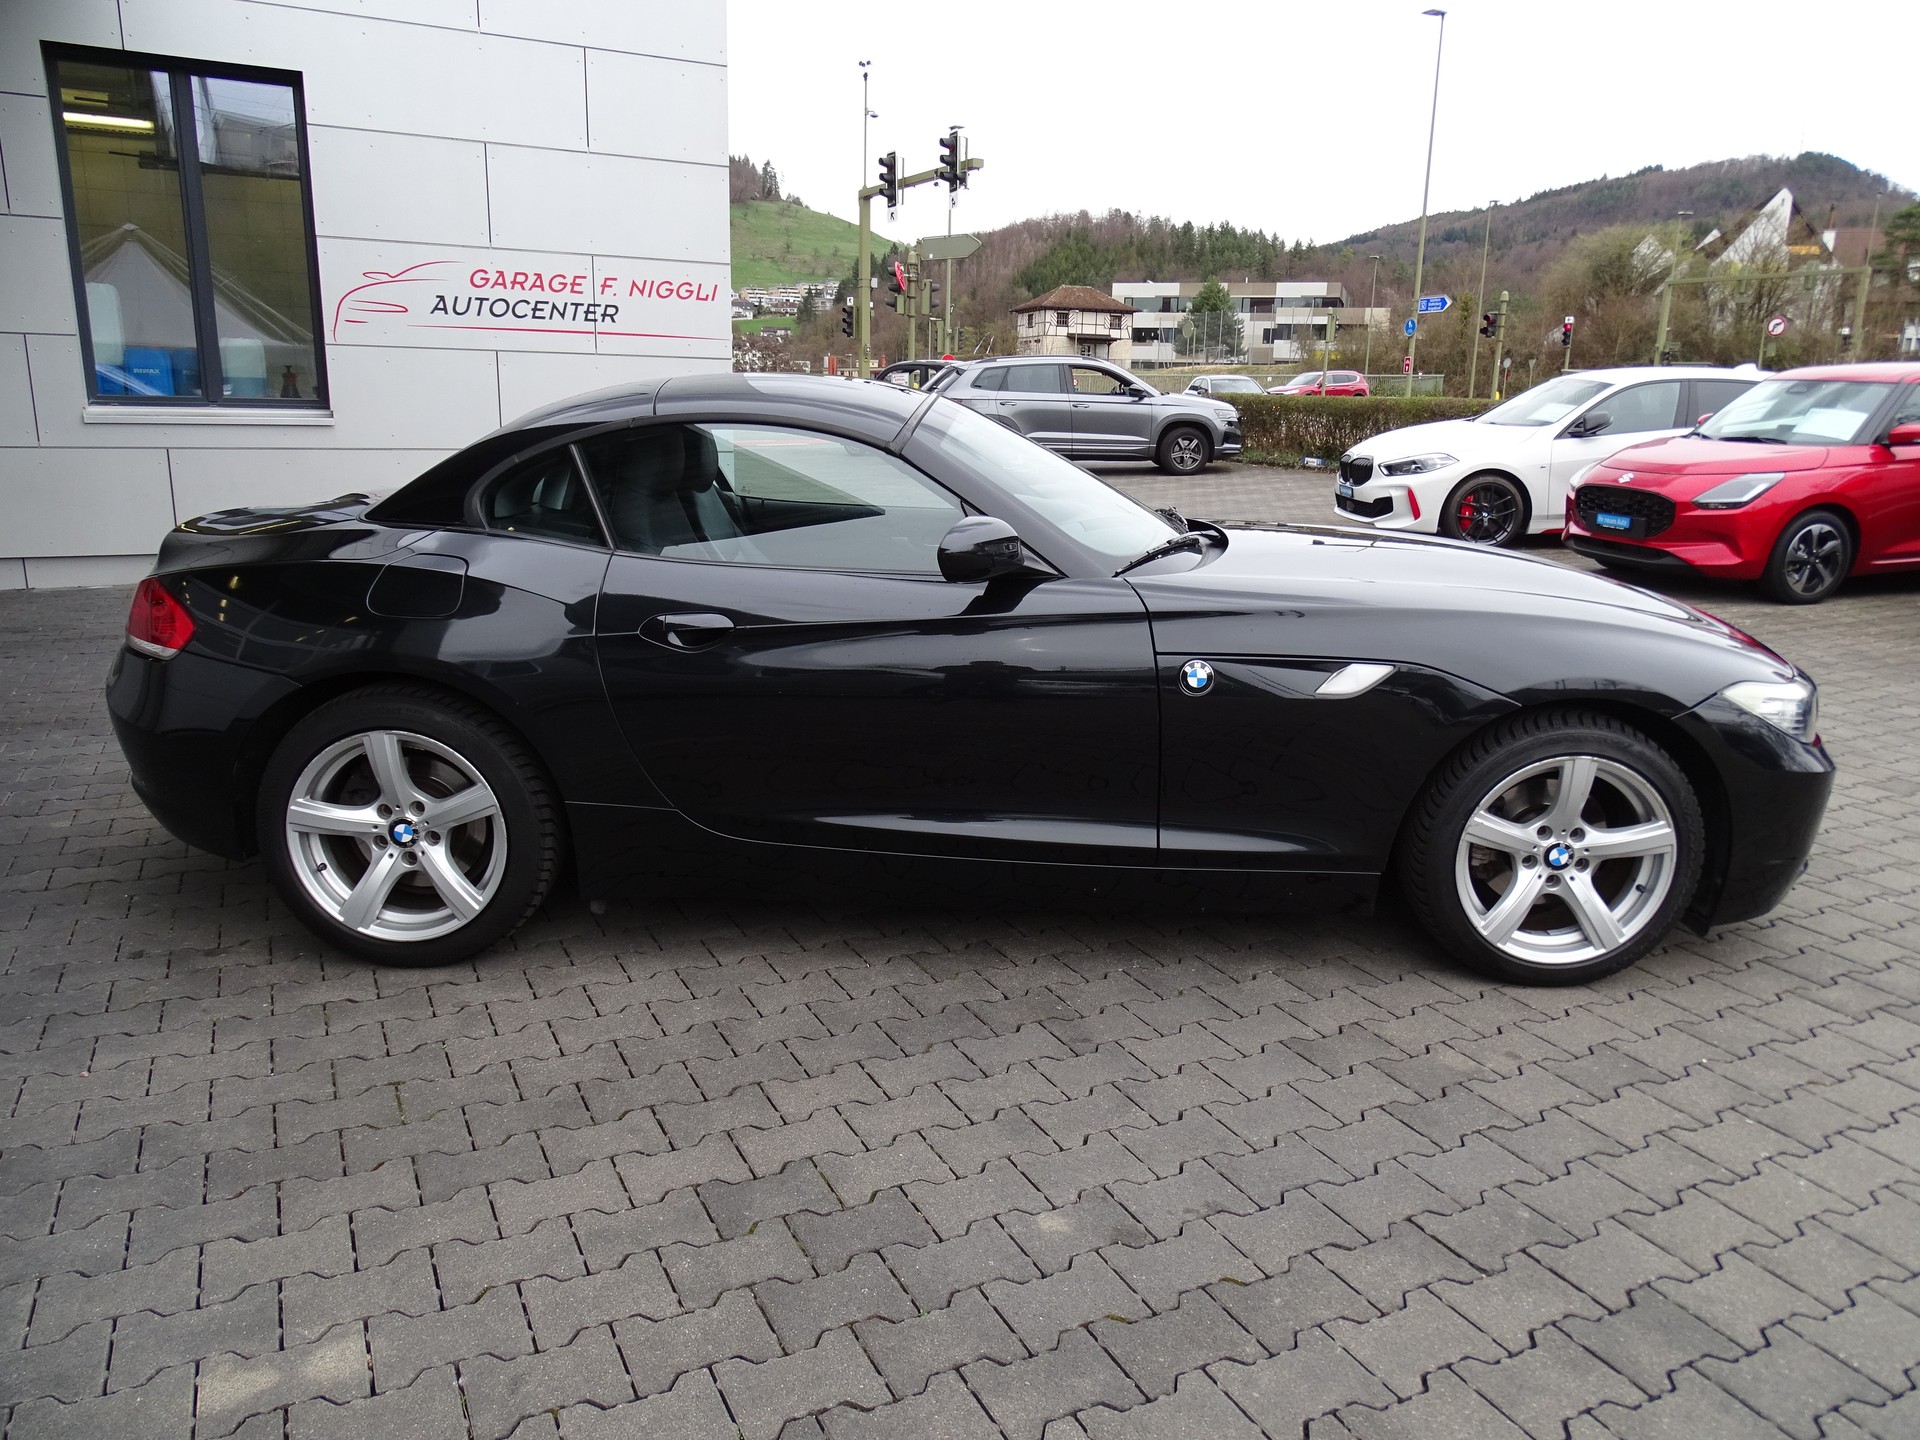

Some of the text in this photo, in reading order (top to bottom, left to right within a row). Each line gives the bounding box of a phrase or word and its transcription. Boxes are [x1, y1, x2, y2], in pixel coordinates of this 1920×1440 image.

[469, 268, 719, 302] GARAGE F. NIGGLI
[430, 295, 620, 324] AUTOCENTER
